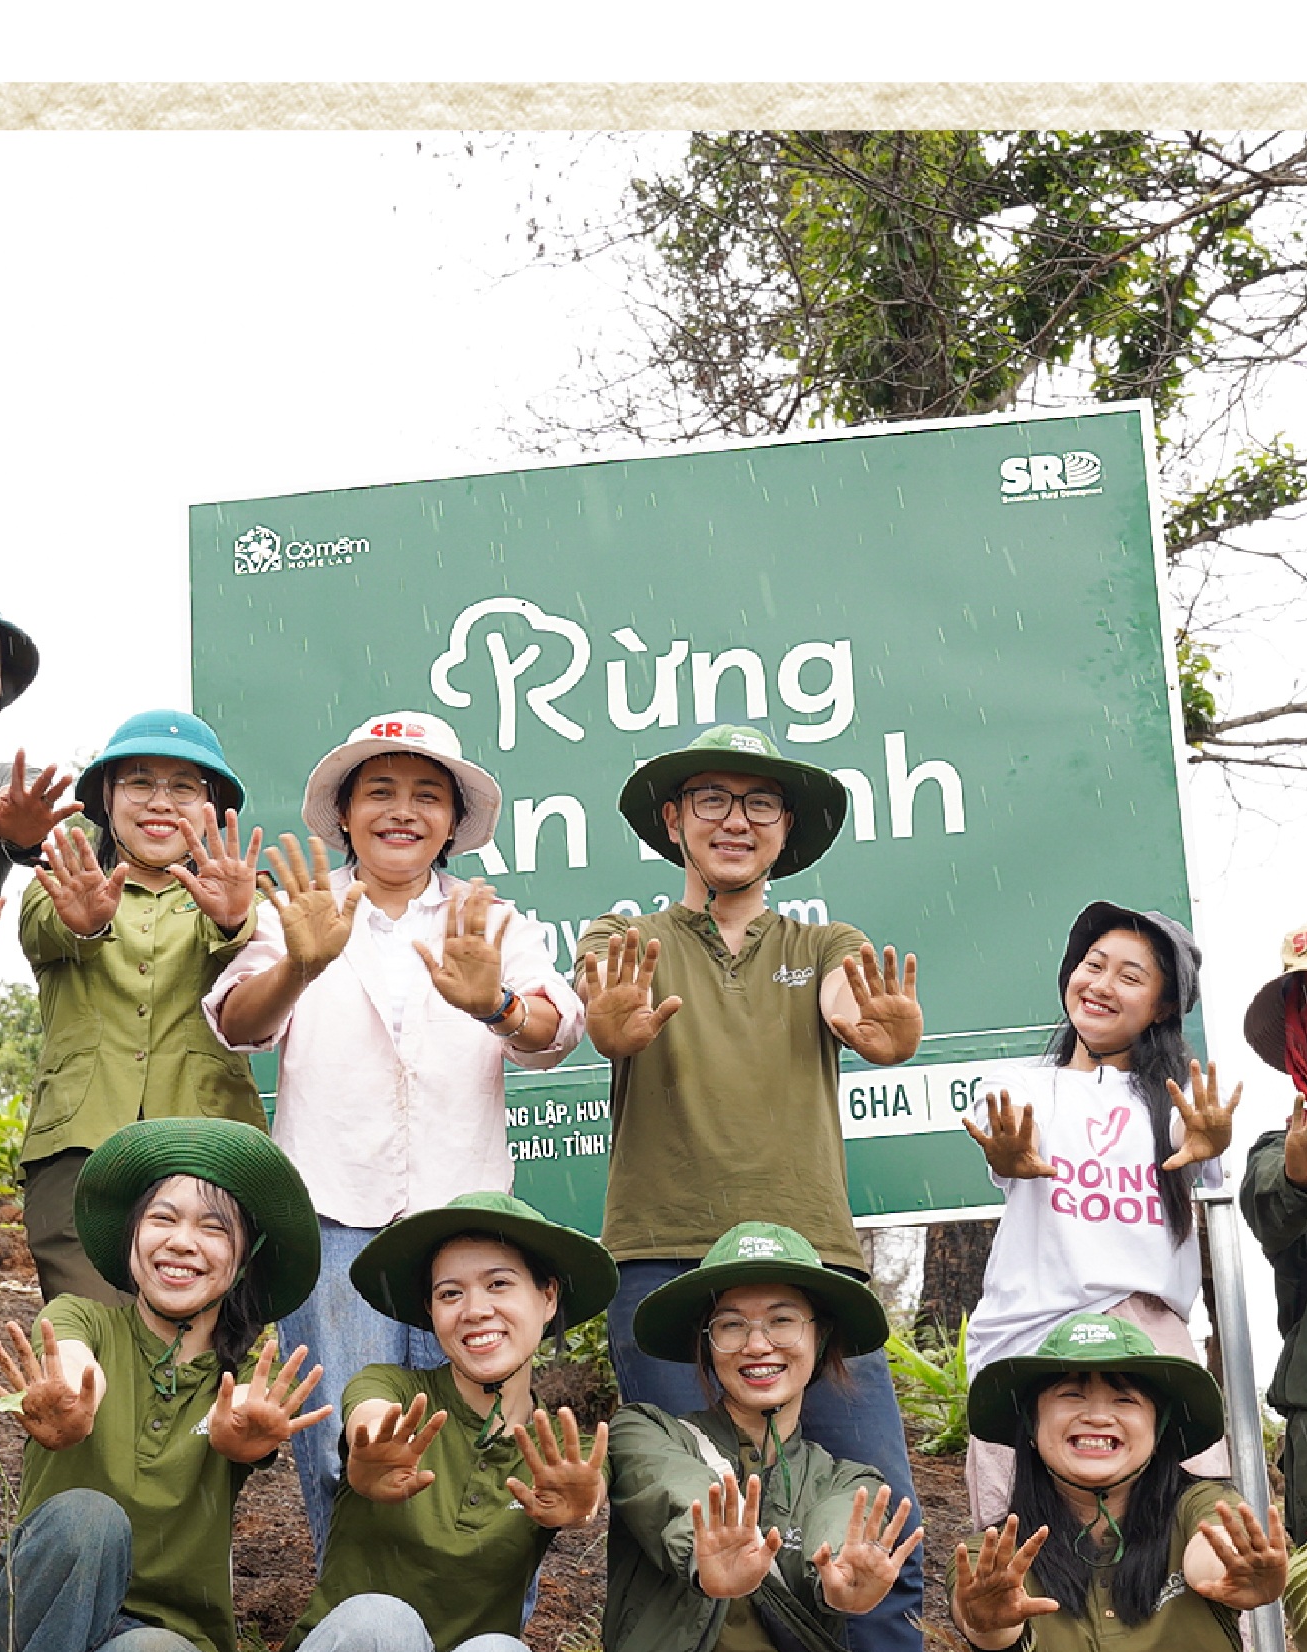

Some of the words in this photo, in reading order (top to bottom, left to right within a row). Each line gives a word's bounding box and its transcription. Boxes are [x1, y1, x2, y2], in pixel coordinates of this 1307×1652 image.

[1000, 451, 1102, 494] SRD
[431, 597, 854, 751] Rừng
[504, 1107, 529, 1127] NG
[534, 1099, 573, 1129] LẬP,
[577, 1100, 611, 1123] HUY
[849, 1084, 912, 1120] 6HA
[508, 1135, 559, 1160] CHÂU,
[562, 1130, 606, 1157] TỈNH
